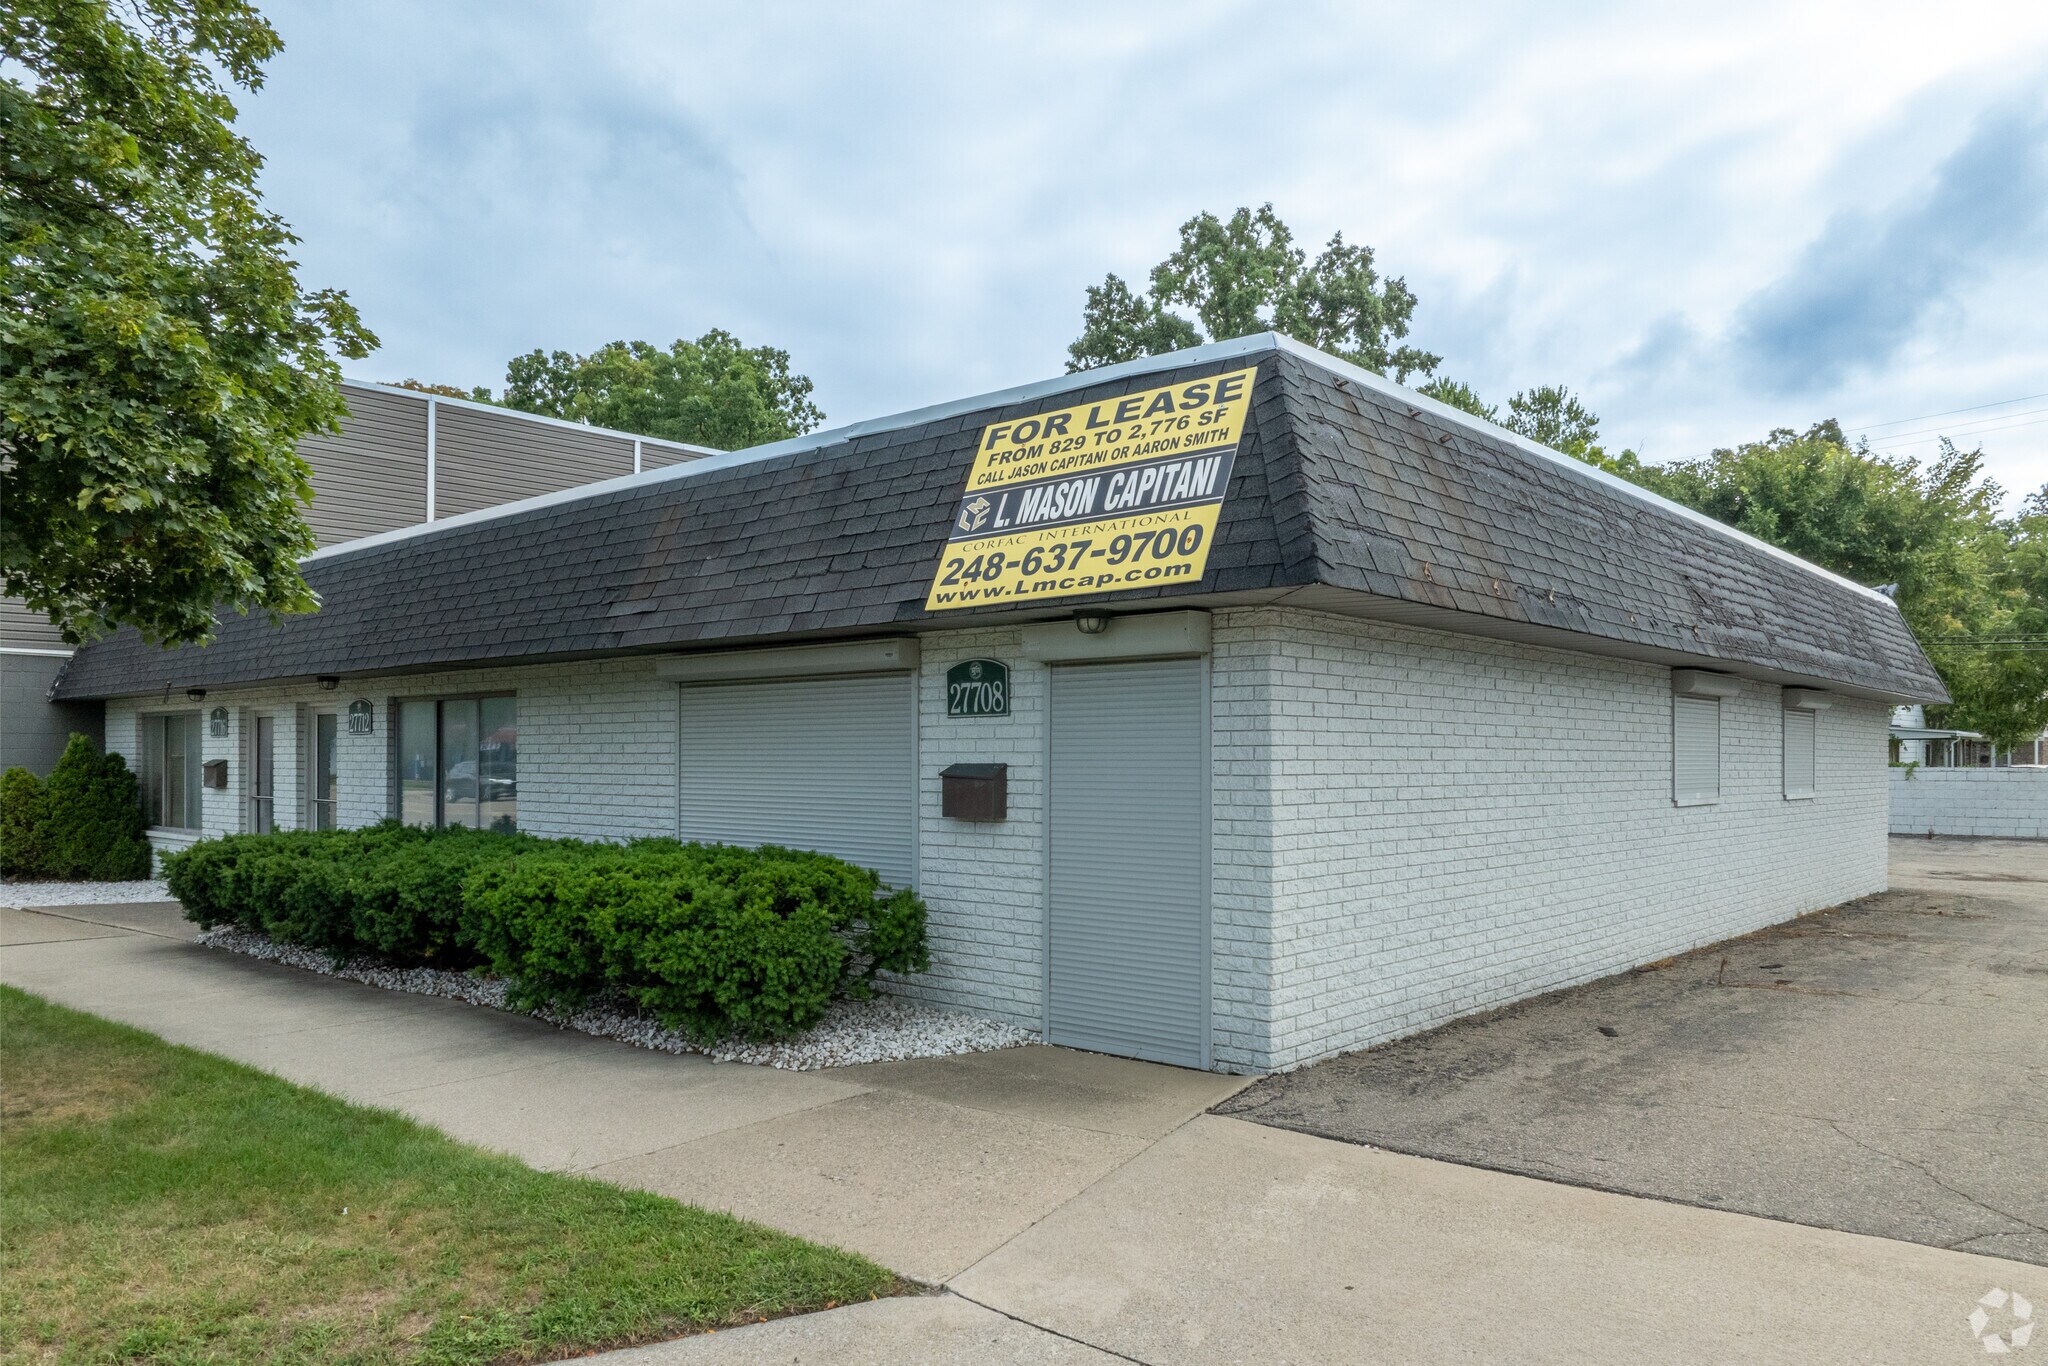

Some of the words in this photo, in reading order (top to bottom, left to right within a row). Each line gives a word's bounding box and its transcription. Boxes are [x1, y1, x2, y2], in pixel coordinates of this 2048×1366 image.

[985, 413, 1072, 451] FOR
[1085, 374, 1246, 430] LEASE
[987, 444, 1044, 467] FROM
[1049, 435, 1086, 456] 829
[1094, 428, 1121, 446] TO
[1128, 415, 1190, 440] 2,776
[1198, 407, 1229, 427] SF
[977, 469, 1004, 485] CALL
[1008, 461, 1048, 479] JASON
[1050, 450, 1108, 471] CAPITANI
[1111, 446, 1129, 460] OR
[1132, 436, 1180, 456] AARON
[1183, 427, 1229, 447] SMITH
[993, 493, 1010, 528] L.
[1015, 477, 1101, 525] MASON
[1104, 456, 1221, 511] CAPITANI
[940, 524, 1203, 587] 248-637-9700
[962, 535, 1027, 552] CORFAC
[1039, 511, 1192, 541] INTERNATIONAL
[936, 563, 1191, 603] www.Lmcap.com
[350, 712, 370, 732] 27712
[950, 681, 1004, 714] 27708
